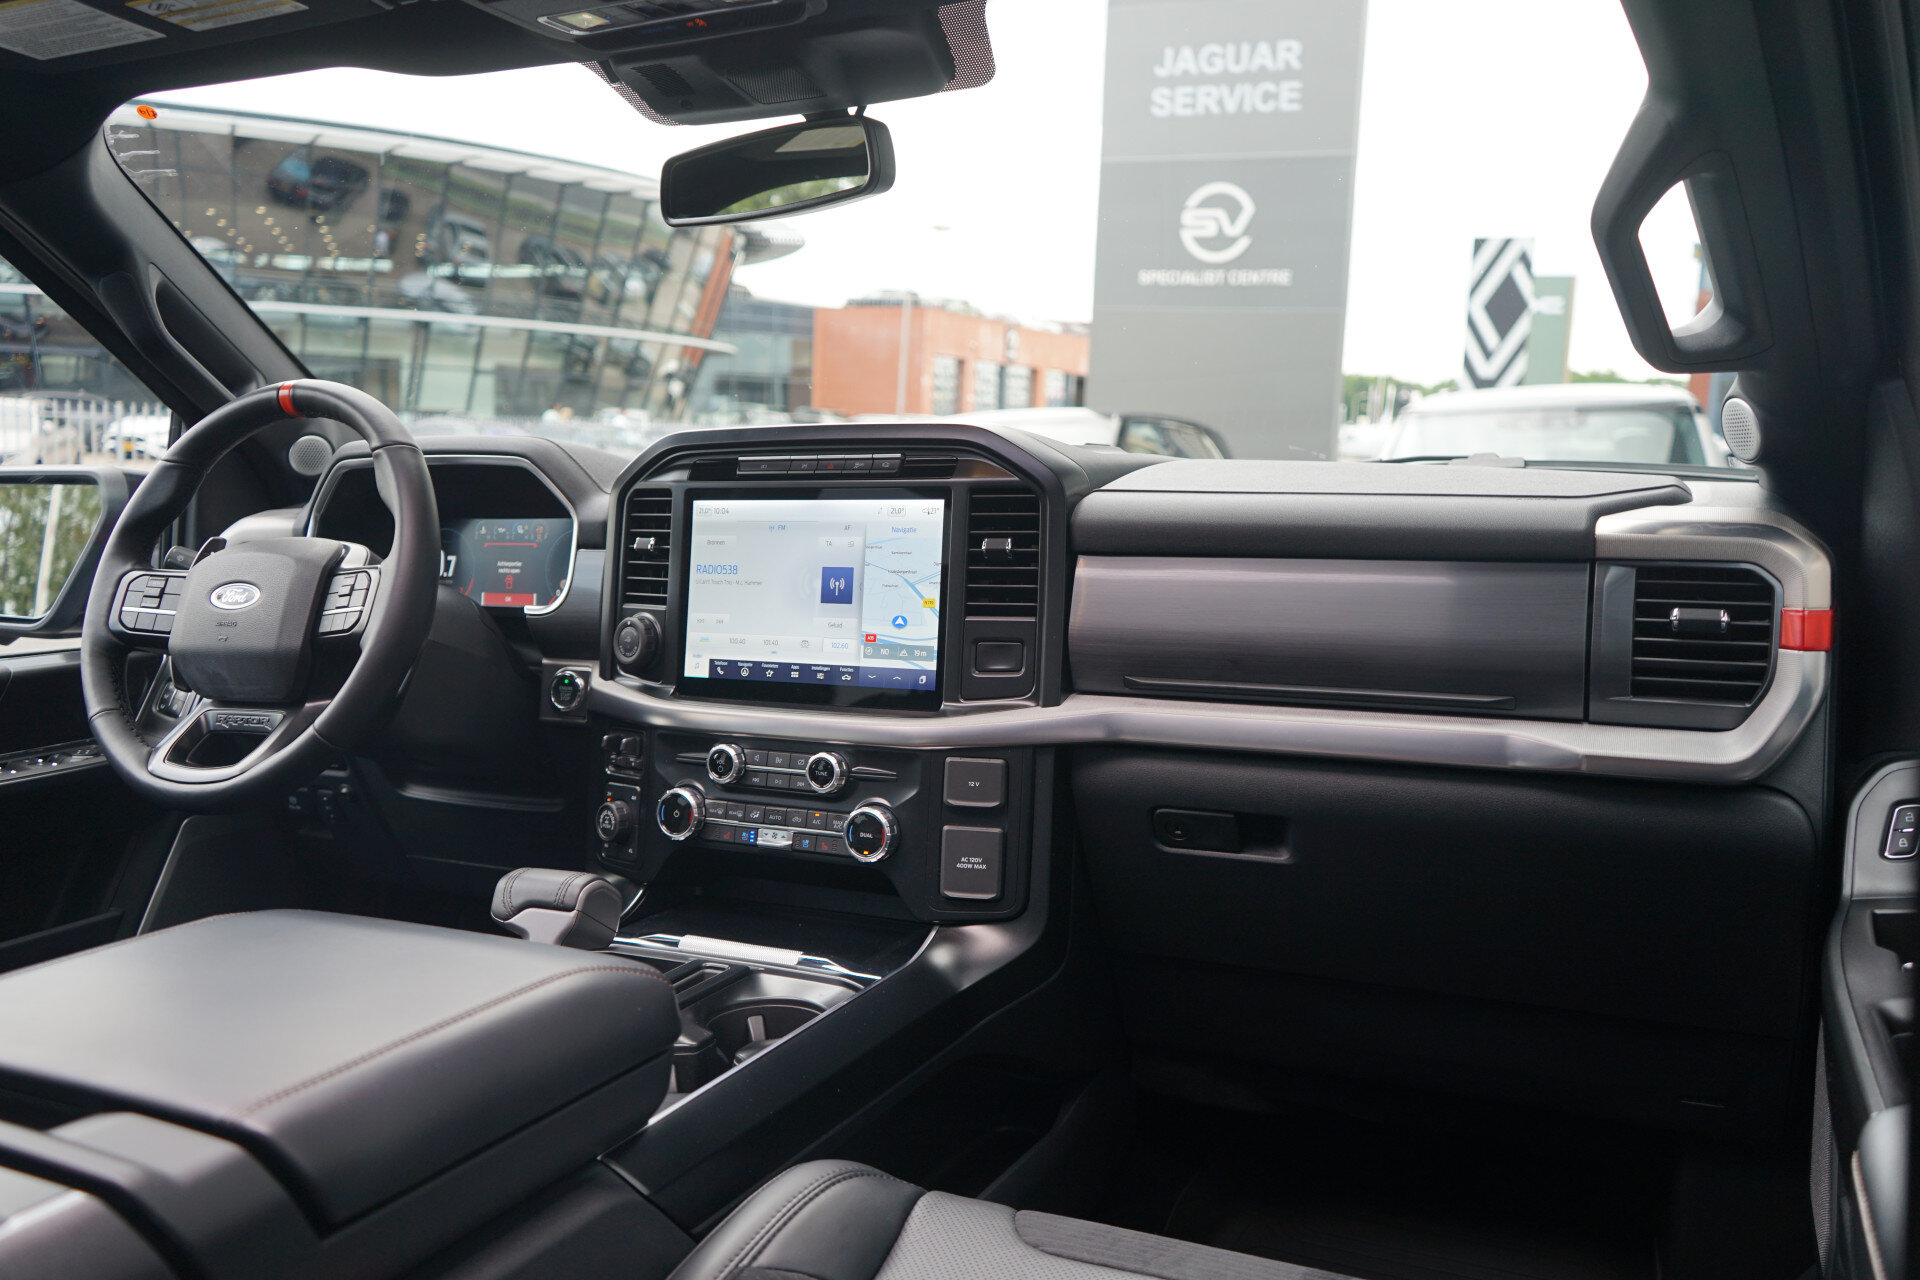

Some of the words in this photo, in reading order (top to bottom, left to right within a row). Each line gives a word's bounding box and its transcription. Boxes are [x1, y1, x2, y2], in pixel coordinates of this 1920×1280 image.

[1153, 38, 1303, 77] JAGUAR
[1150, 79, 1303, 118] SERVICE
[1137, 268, 1225, 286] SPECIALIST
[1226, 268, 1292, 286] CENTRE
[713, 507, 729, 515] 10:04
[891, 526, 917, 534] Navigatie
[696, 564, 738, 575] RADIO538
[220, 588, 248, 603] Ford
[216, 714, 272, 730] RAPTOR
